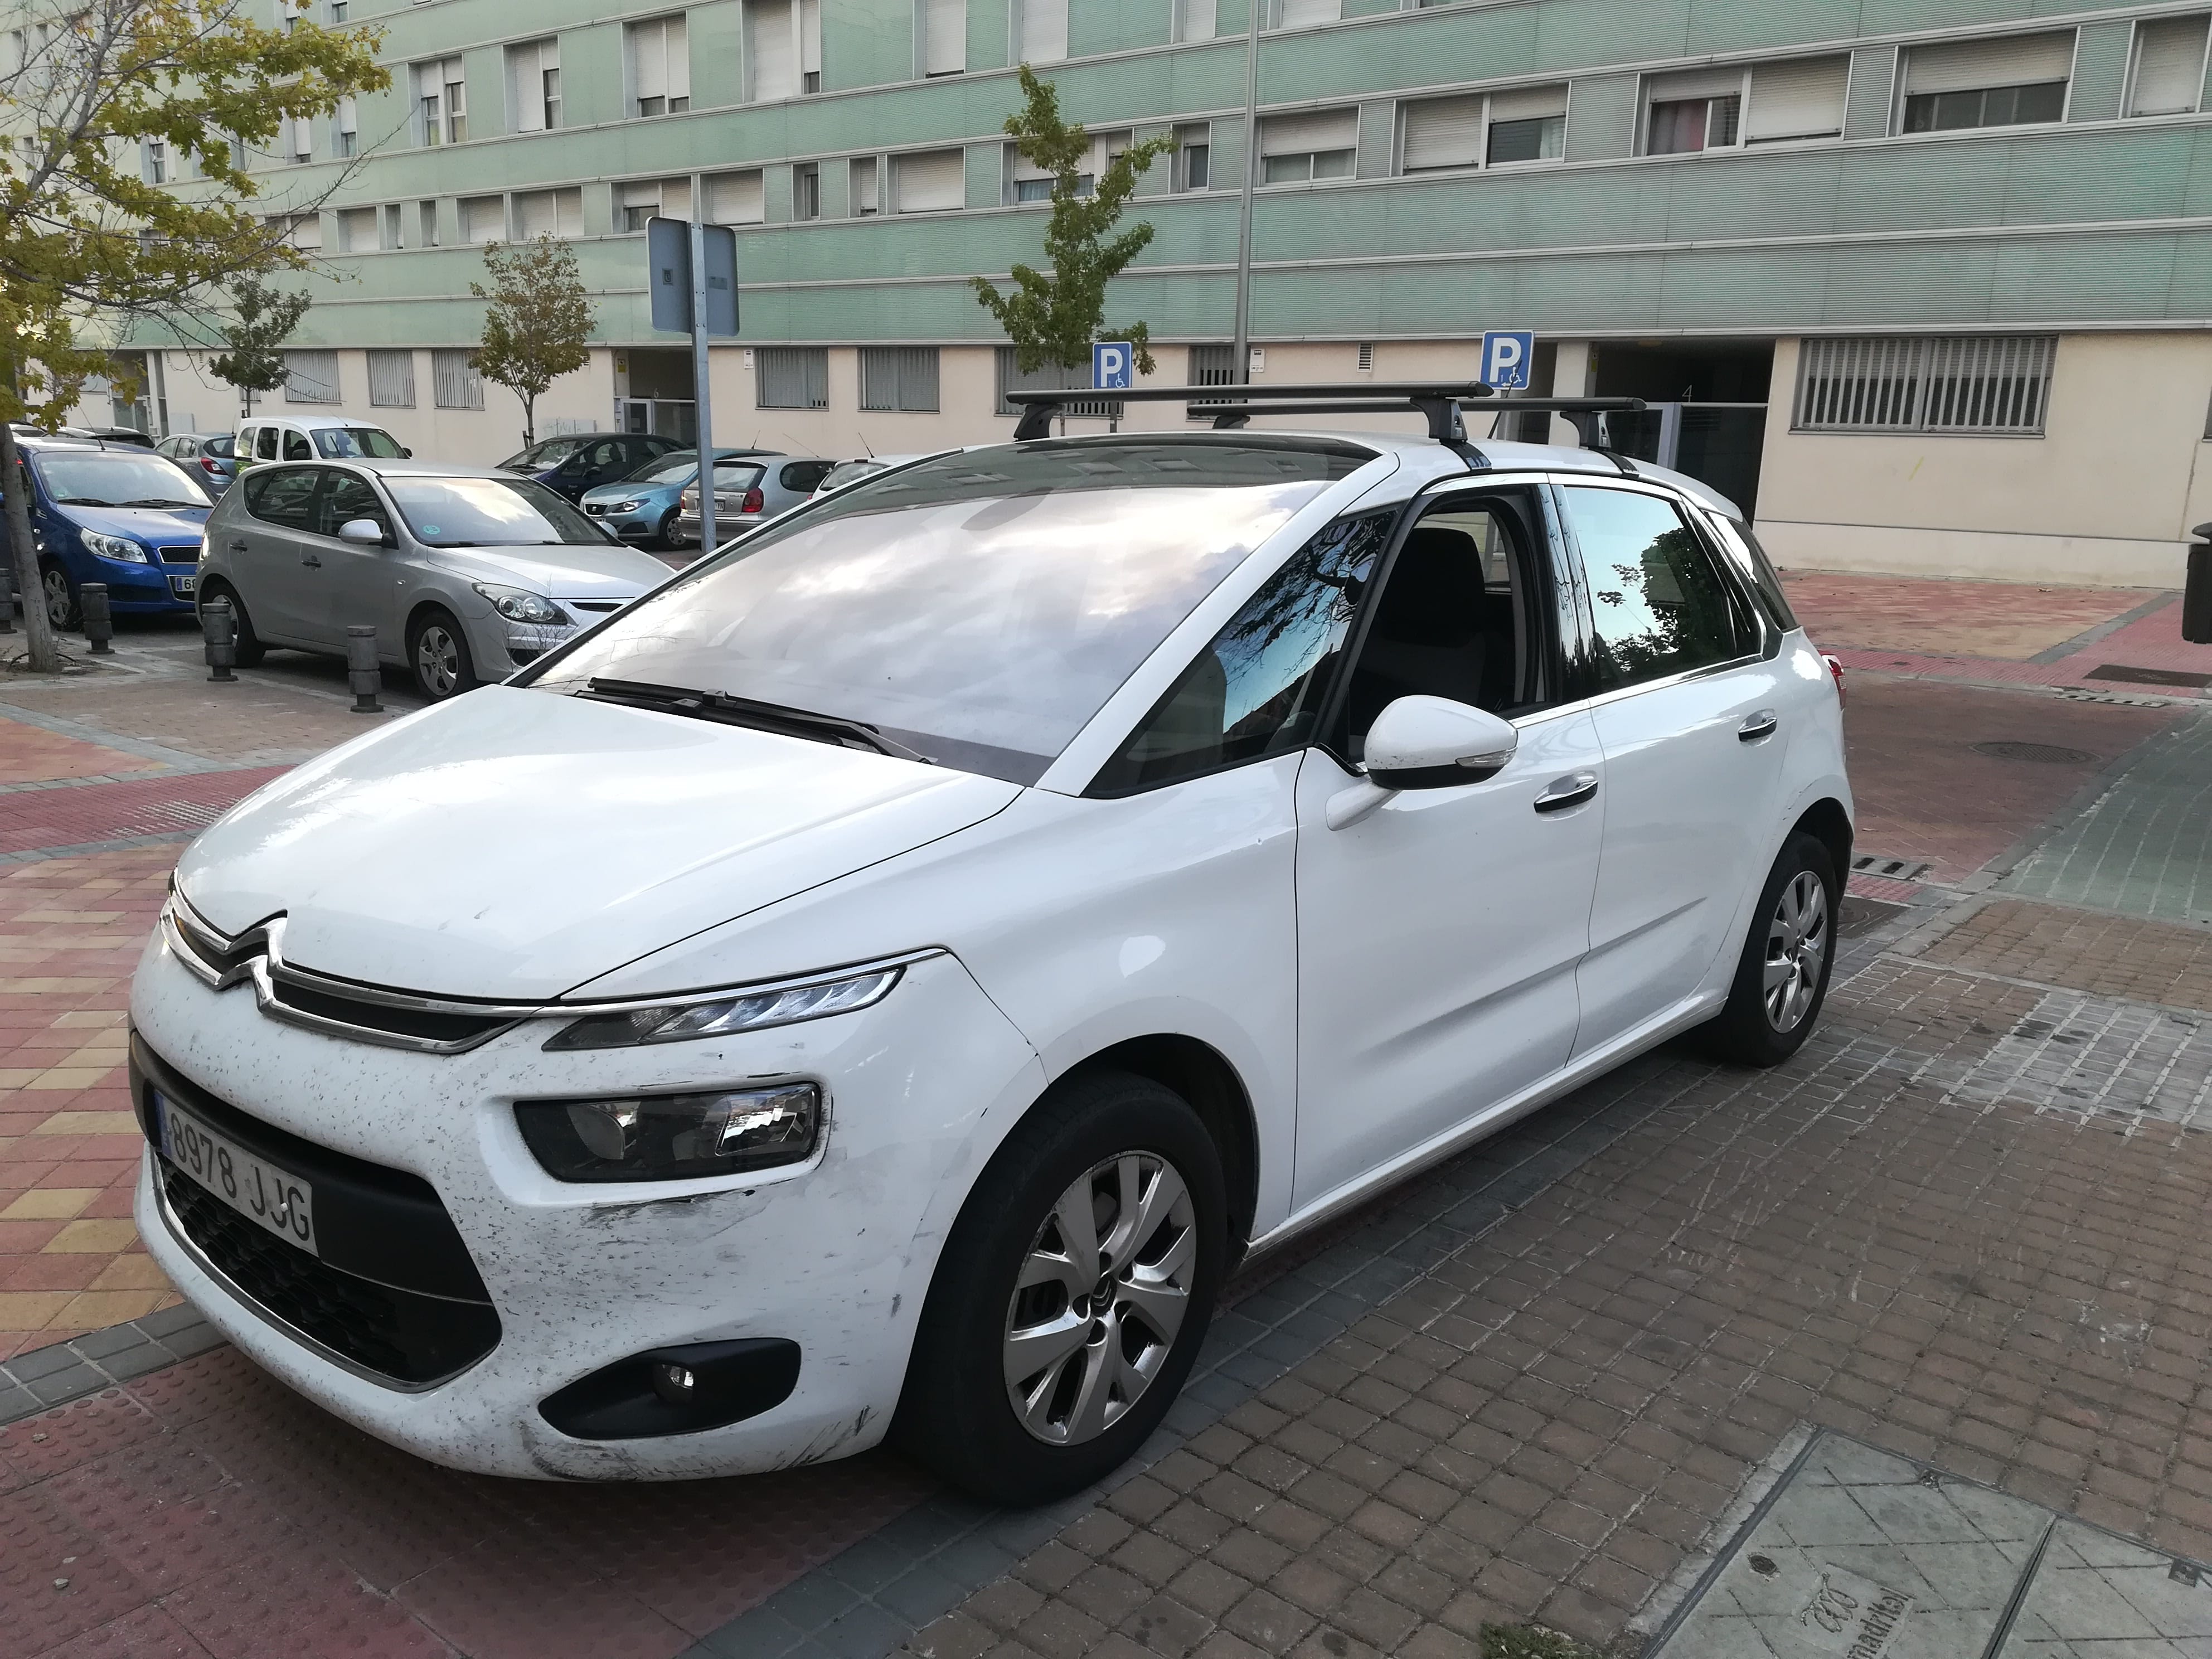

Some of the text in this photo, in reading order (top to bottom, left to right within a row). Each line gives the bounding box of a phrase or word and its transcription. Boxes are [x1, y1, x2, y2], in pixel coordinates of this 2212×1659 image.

[1100, 348, 1123, 387] P
[1489, 337, 1521, 382] P
[653, 388, 659, 398] 6
[1681, 385, 1693, 402] 4
[170, 1113, 310, 1241] 8978 JJG
